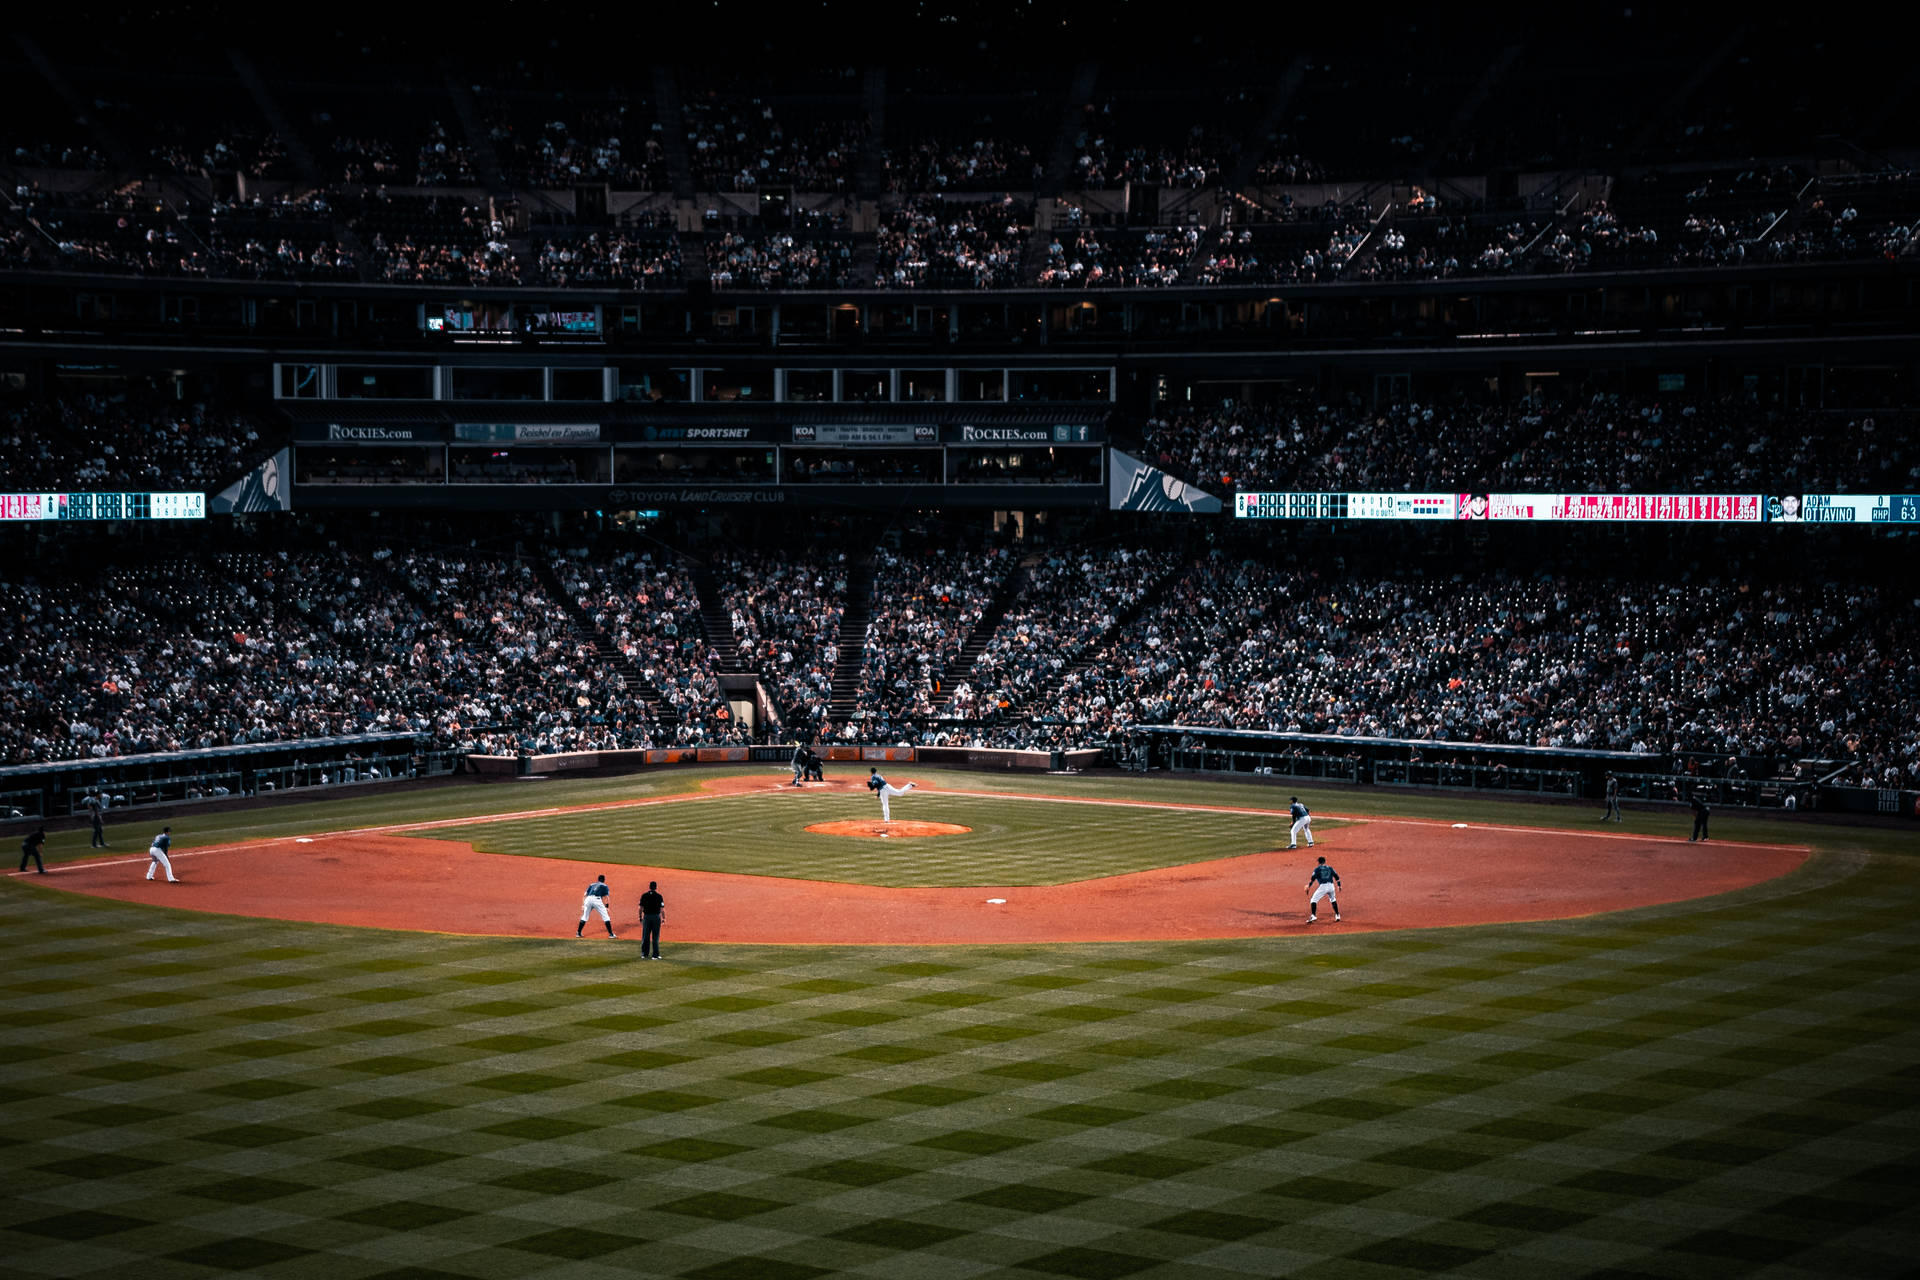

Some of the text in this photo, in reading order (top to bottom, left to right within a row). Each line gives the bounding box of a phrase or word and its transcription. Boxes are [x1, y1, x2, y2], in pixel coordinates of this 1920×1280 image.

[328, 424, 412, 440] ROCKIES.com
[686, 428, 750, 438] SPORTSNET
[795, 427, 814, 436] KOA
[916, 427, 934, 436] KOA
[962, 424, 1048, 440] ROCKIES.com
[630, 490, 678, 502] TOYOTA
[754, 490, 784, 502] CLUB
[1261, 496, 1265, 504] 2
[1270, 496, 1274, 504] 0
[1280, 496, 1284, 504] 0
[1292, 496, 1296, 504] 0
[1301, 496, 1305, 504] 0
[1311, 496, 1314, 504] 2
[1322, 496, 1327, 504] 0
[1806, 496, 1831, 506] ADAM
[1878, 496, 1883, 506] 0
[1261, 507, 1265, 516] 2
[1270, 507, 1274, 516] 0
[1280, 507, 1284, 516] 0
[1292, 507, 1296, 516] 0
[1301, 507, 1305, 516] 0
[1311, 507, 1314, 516] 1
[1323, 507, 1327, 516] 0
[1493, 506, 1528, 518] PERALTA
[1566, 505, 1755, 518] .297 152/511 24 5 27 78 3 42 .355
[1806, 508, 1852, 520] OTTAVINO
[1873, 510, 1888, 519] RHP
